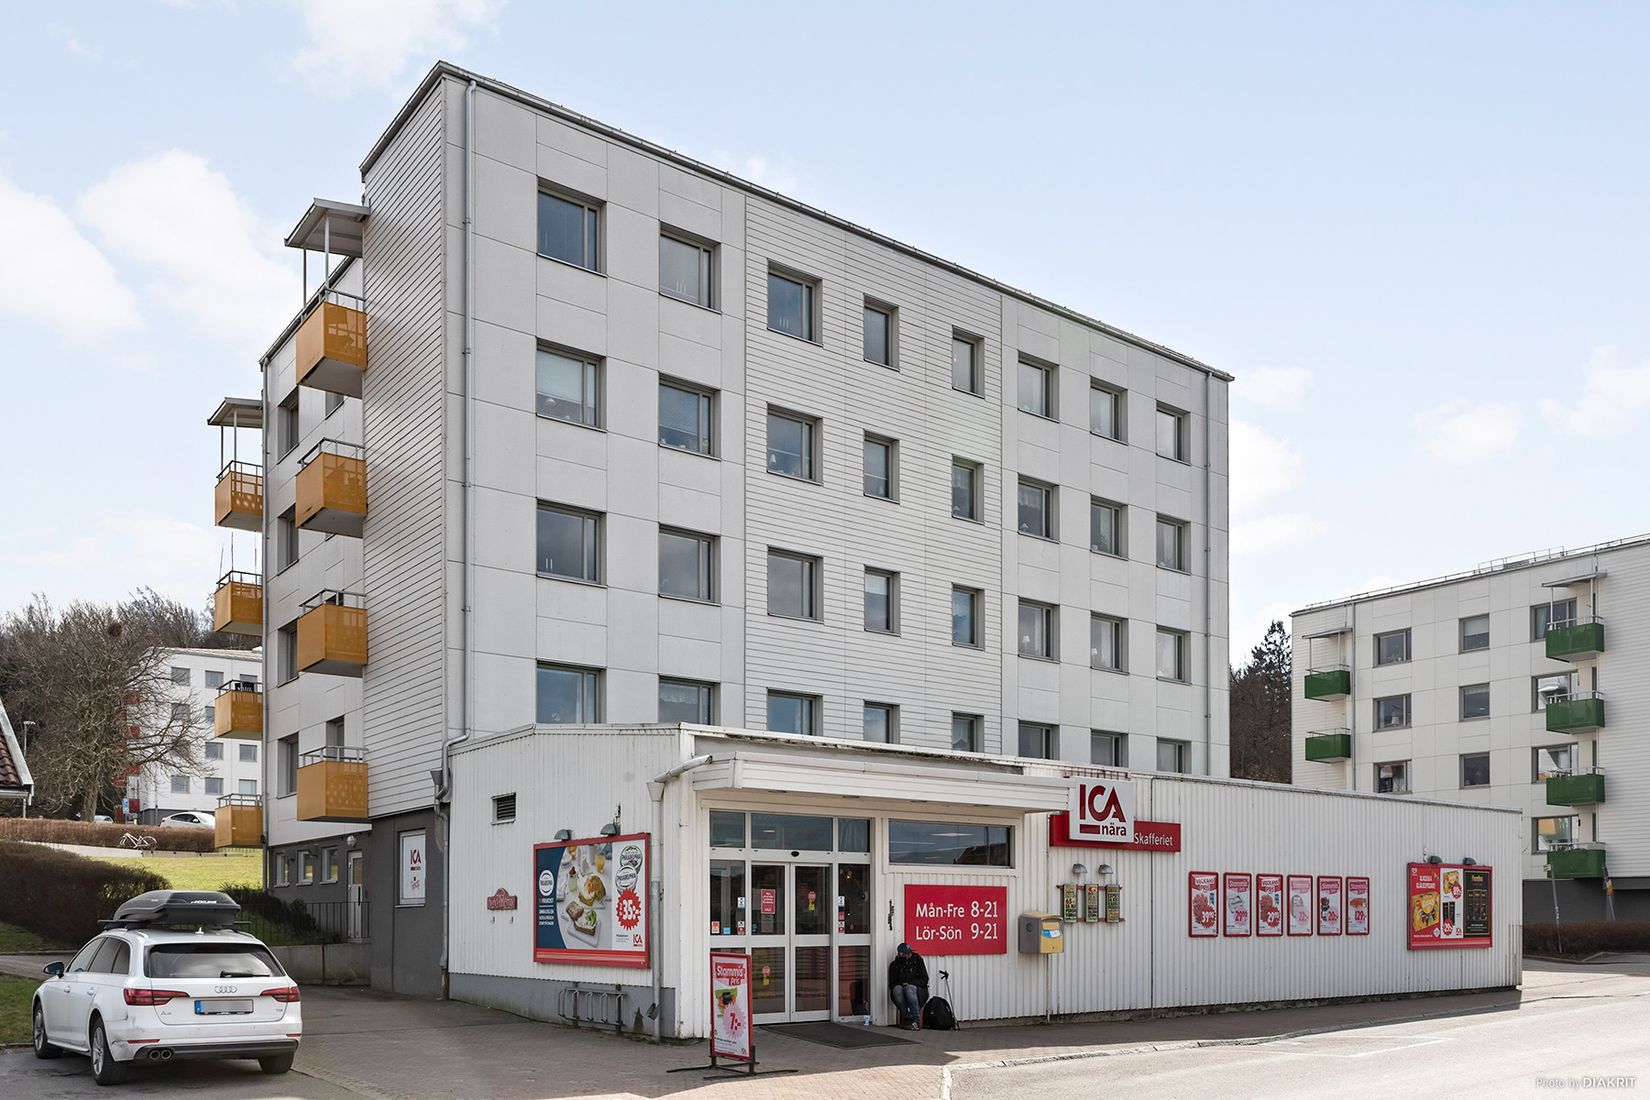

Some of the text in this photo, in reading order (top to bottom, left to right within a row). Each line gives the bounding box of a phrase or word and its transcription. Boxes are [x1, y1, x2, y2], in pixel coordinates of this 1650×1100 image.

[1079, 783, 1126, 822] ICA
[1102, 823, 1127, 836] nära
[1134, 832, 1173, 846] Skafferiet
[410, 849, 421, 864] ICA
[915, 901, 998, 918] Mån-Fre 8-21
[633, 933, 643, 943] ICA
[915, 923, 998, 941] Lör-Sön 9-21
[716, 965, 744, 978] Stammis
